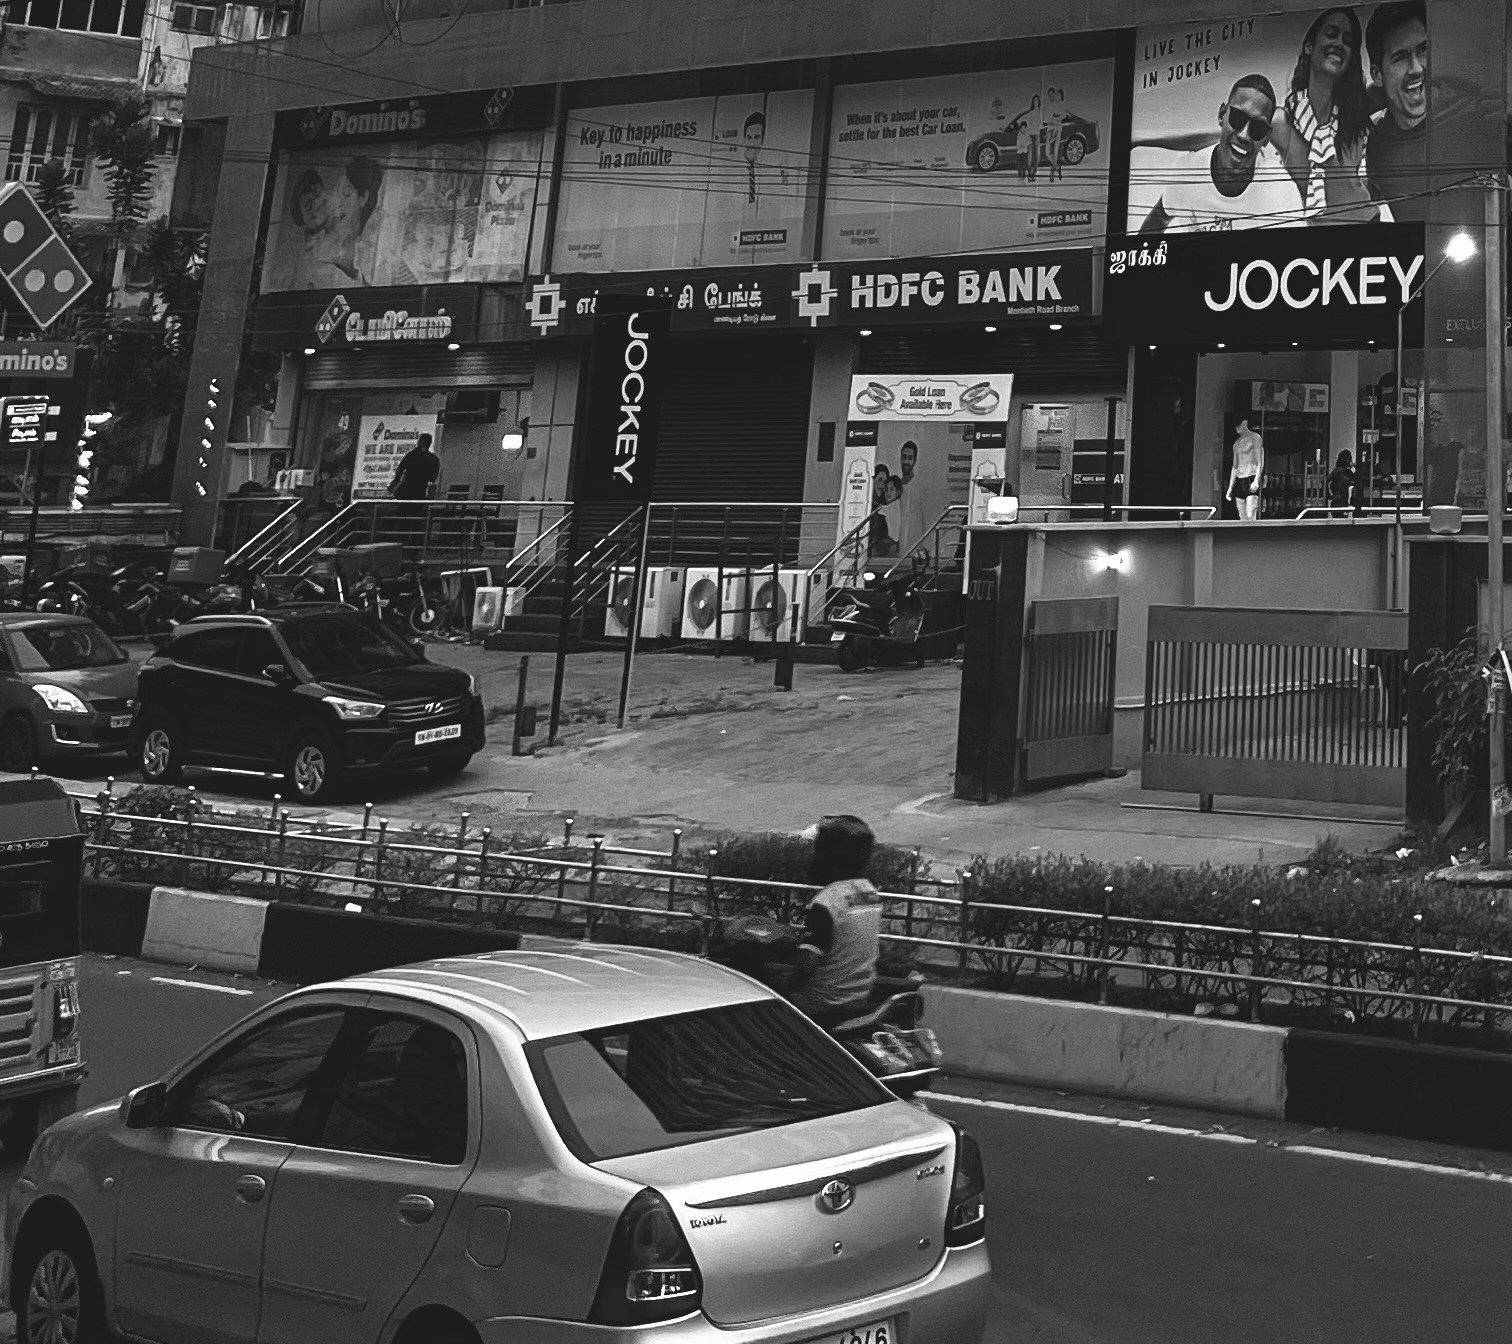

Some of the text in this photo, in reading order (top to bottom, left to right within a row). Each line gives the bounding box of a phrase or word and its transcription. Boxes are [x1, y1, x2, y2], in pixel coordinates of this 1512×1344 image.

[1144, 18, 1255, 61] LIVE THE CITY
[1143, 54, 1221, 89] IN JOCKEY
[329, 100, 427, 136] Domino's
[847, 106, 961, 126] When it's about your car,
[580, 120, 698, 148] Key to happiness
[839, 121, 966, 142] settle for the best Car Loan.
[599, 150, 611, 169] in
[624, 147, 672, 167] minute
[1040, 213, 1089, 225] HDFC BANK
[763, 232, 784, 242] BANK
[851, 265, 1062, 309] HDFC BANK
[1204, 254, 1424, 312] JOCKEY
[1055, 304, 1080, 313] Branch
[613, 313, 649, 483] JOCKEY
[927, 386, 946, 397] Loan
